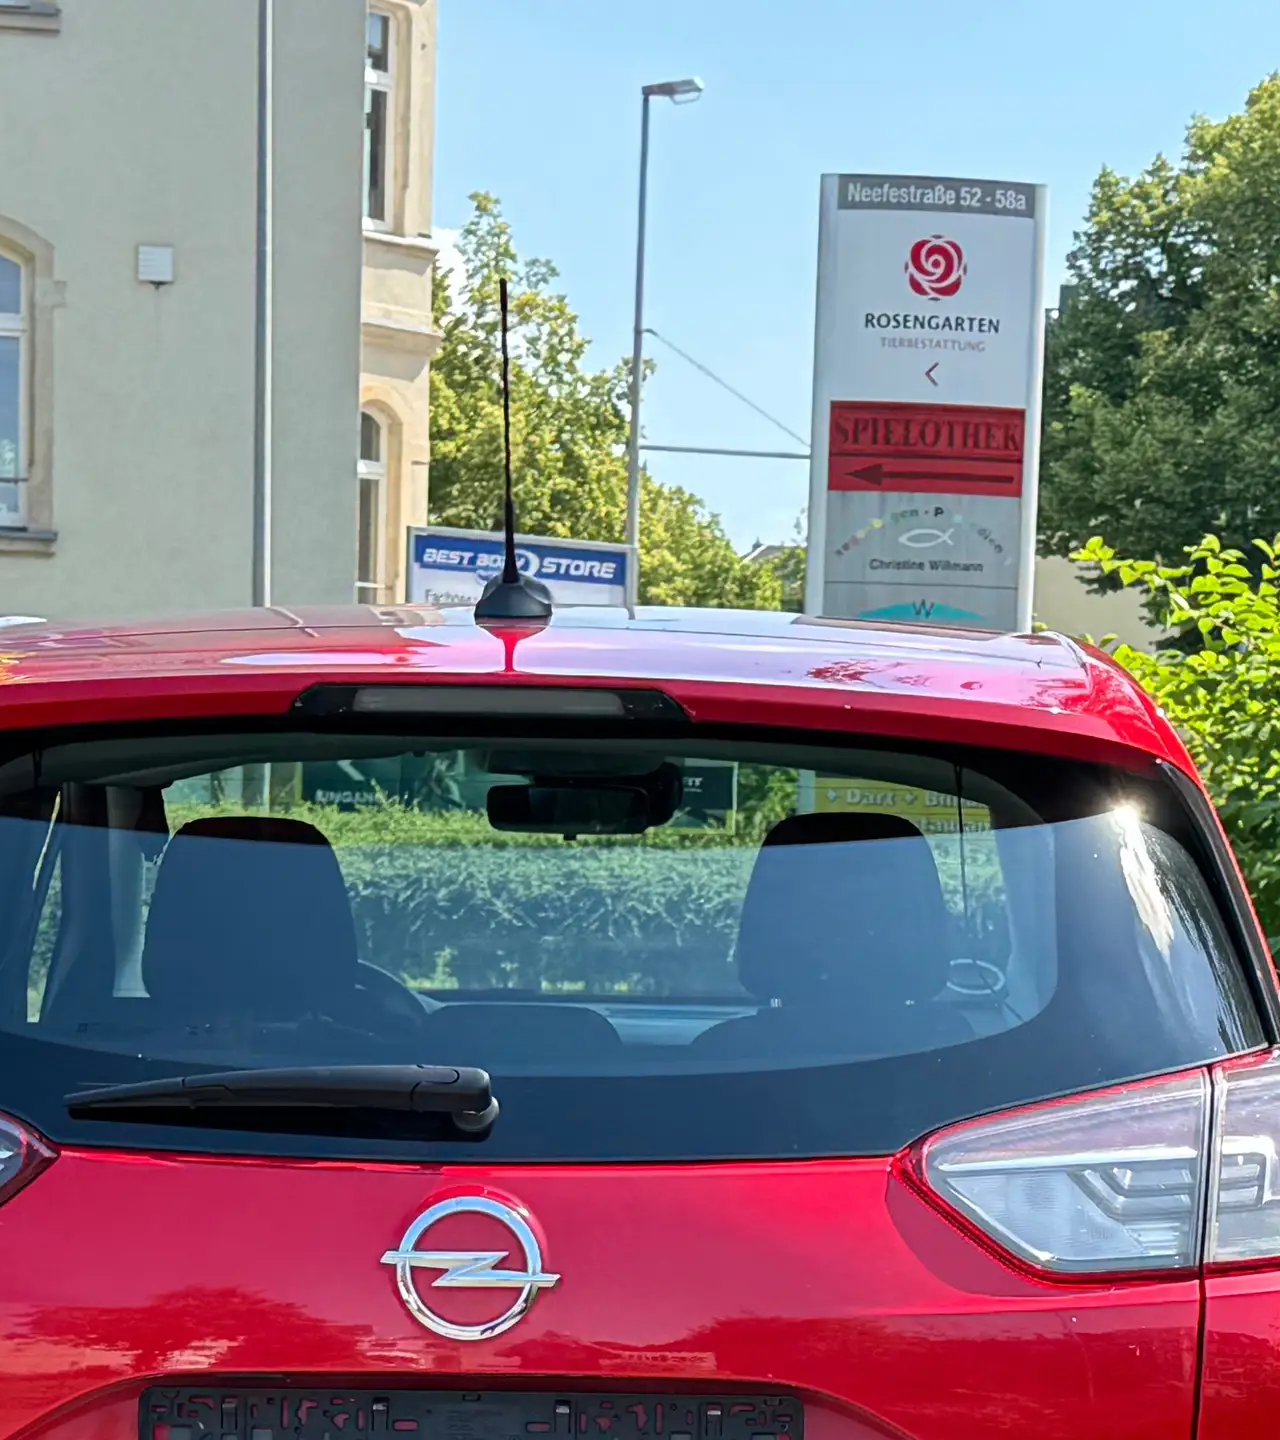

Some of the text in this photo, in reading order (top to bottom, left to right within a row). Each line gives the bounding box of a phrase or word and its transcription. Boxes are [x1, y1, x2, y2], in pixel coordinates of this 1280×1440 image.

[847, 182, 956, 206] Neefestraße
[960, 187, 982, 207] 52
[994, 190, 1028, 210] 58a
[864, 312, 1001, 334] ROSENGARTEN
[880, 336, 986, 352] TIERBESTATTUNG
[835, 416, 1021, 451] SPIELOTHEK
[423, 548, 474, 567] BEST
[541, 557, 617, 579] STORE
[869, 558, 926, 573] Christine
